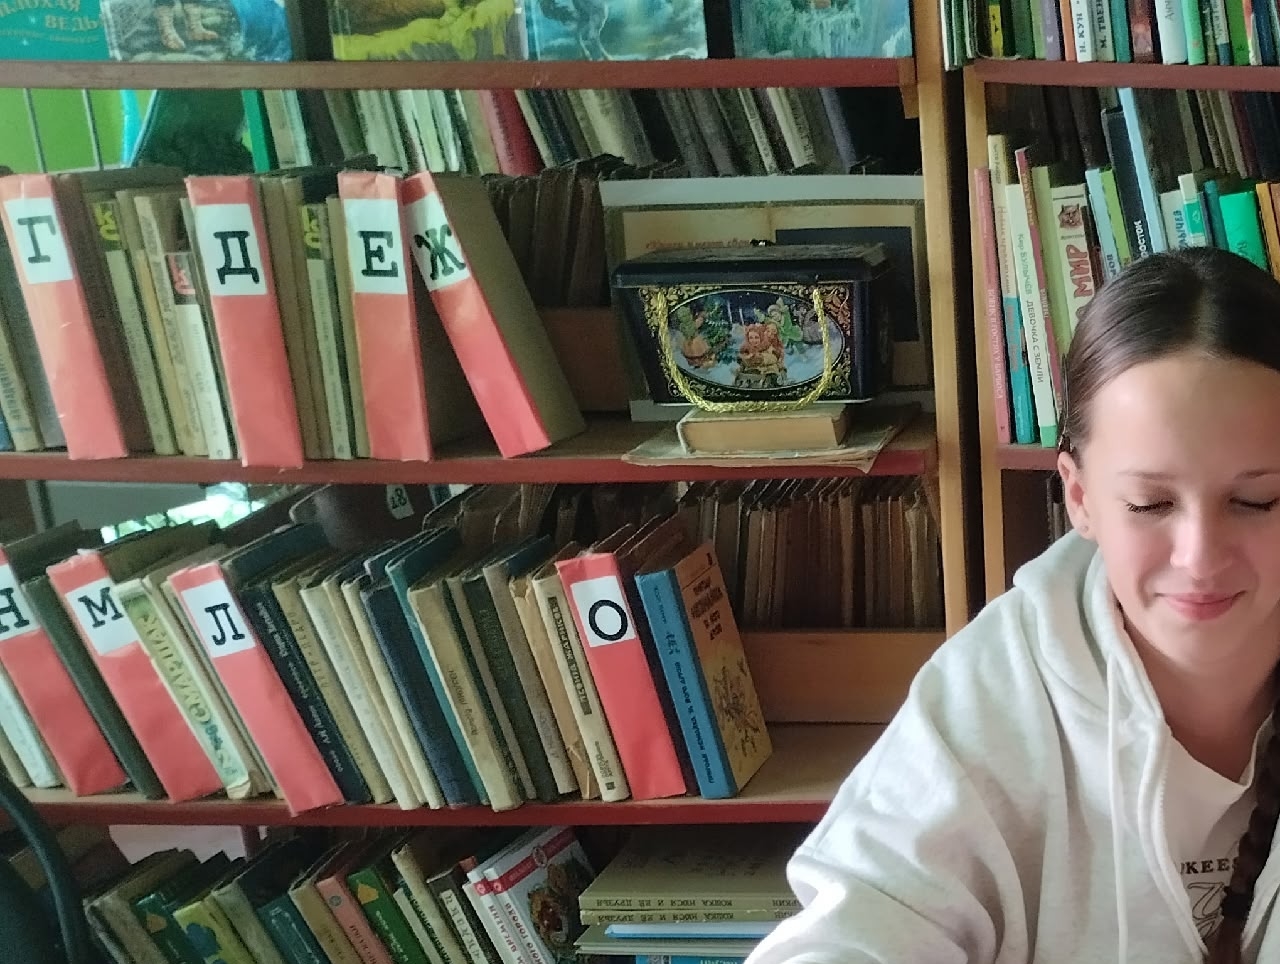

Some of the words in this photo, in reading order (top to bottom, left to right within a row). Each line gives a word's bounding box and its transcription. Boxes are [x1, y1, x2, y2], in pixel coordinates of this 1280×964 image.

[17, 215, 56, 263] Г
[213, 231, 260, 284] Д
[358, 231, 398, 277] Е
[414, 224, 466, 280] Ж
[1066, 243, 1095, 299] МИР
[1026, 300, 1039, 346] ДЕВОЧКА
[1032, 351, 1045, 383] ЗЕМЛИ
[0, 587, 30, 634] Н
[78, 586, 124, 628] М
[205, 603, 246, 646] Л
[588, 599, 628, 641] О
